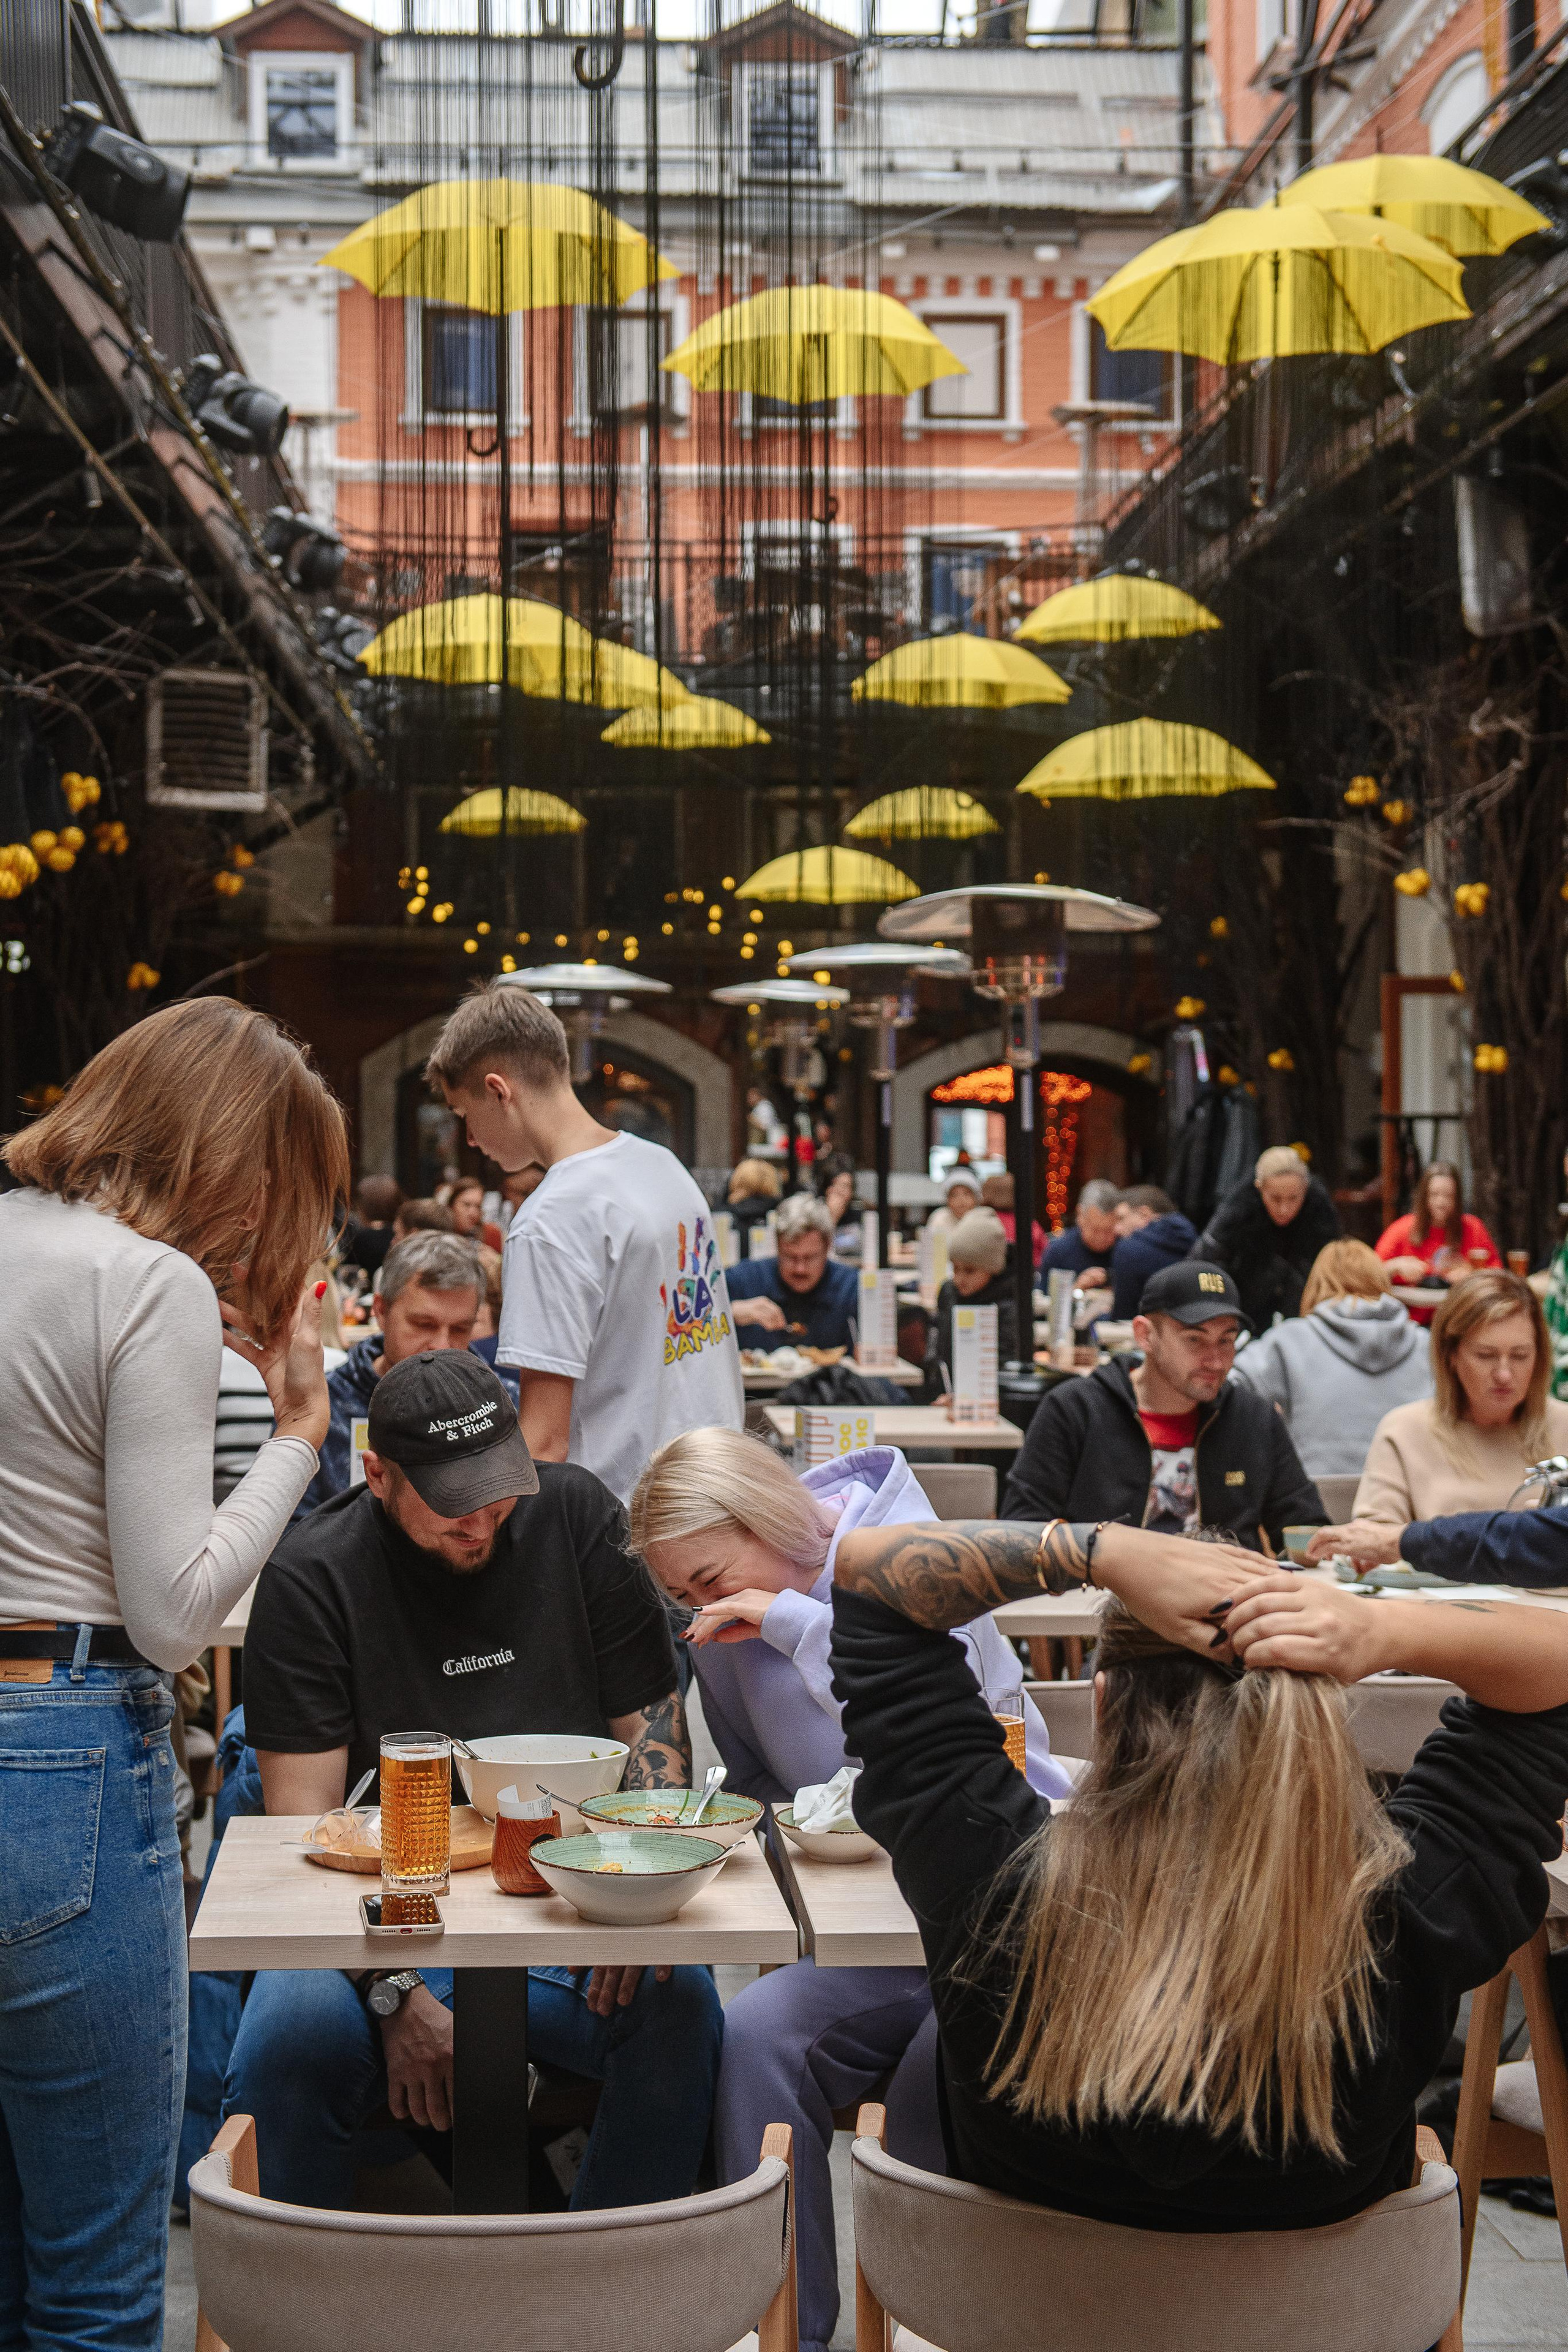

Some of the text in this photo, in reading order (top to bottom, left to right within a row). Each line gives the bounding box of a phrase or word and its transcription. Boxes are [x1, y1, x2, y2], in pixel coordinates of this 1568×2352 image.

[673, 1276, 713, 1324] LA
[428, 1400, 498, 1434] Abercrombie
[446, 1417, 494, 1442] & Fitch
[442, 1648, 516, 1676] California
